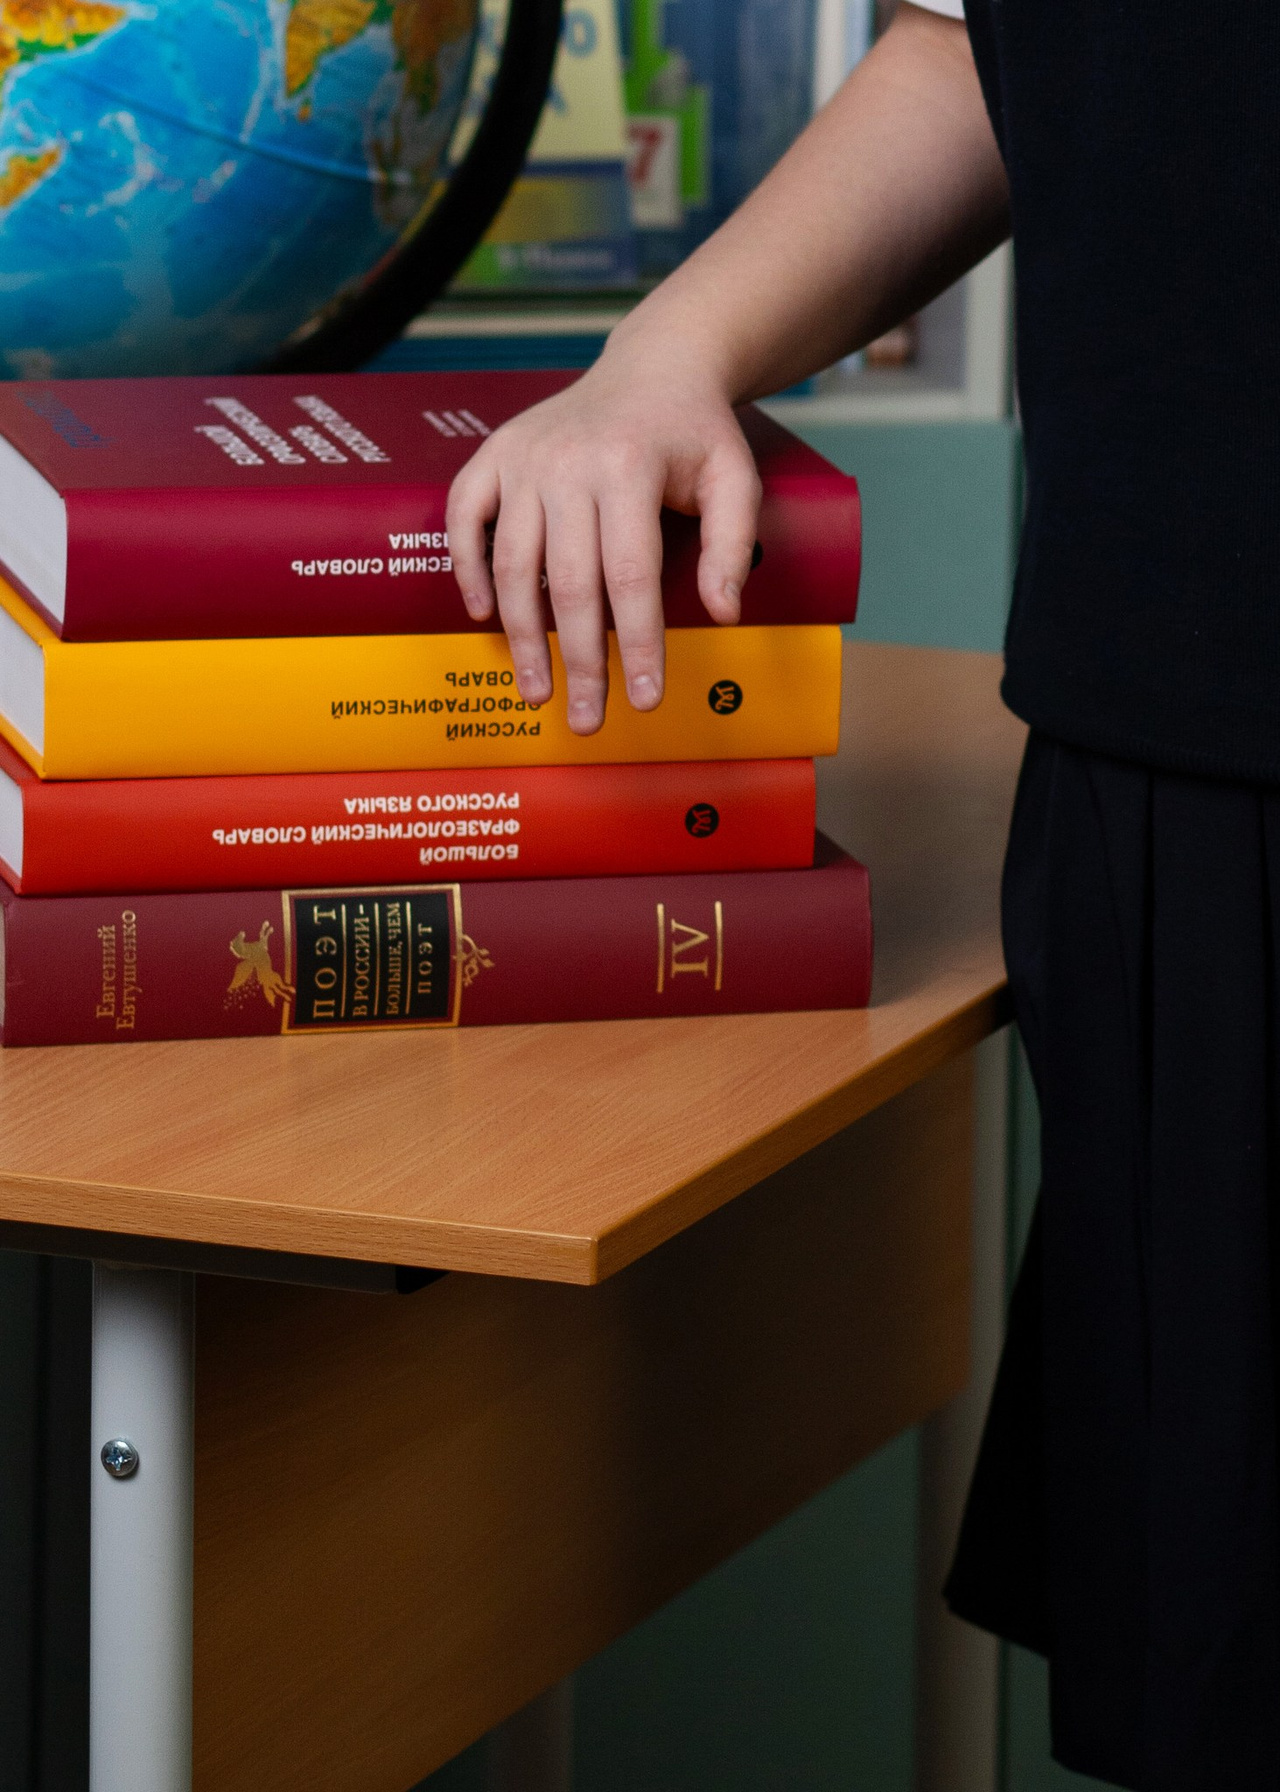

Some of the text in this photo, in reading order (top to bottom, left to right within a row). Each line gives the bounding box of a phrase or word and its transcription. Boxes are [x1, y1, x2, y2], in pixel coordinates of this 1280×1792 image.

[291, 558, 384, 576] СЛОВАРЬ
[445, 670, 514, 687] ОВАРЬ
[445, 721, 541, 742] РУССКИЙ
[343, 792, 520, 815] РУССКОГО ЯЗЫКА
[212, 818, 520, 846] ФРАЗЕОЛОГИЧЕСКИЙ СЛОВАРЬ
[419, 843, 520, 866] БОЛЬШОЙ
[417, 923, 433, 994] ПОЭТ
[671, 918, 710, 979] IV
[96, 924, 115, 1018] Евгений
[116, 909, 142, 1029] Евтушенко
[313, 905, 337, 1018] ПОЭТ
[352, 1004, 368, 1017] В
